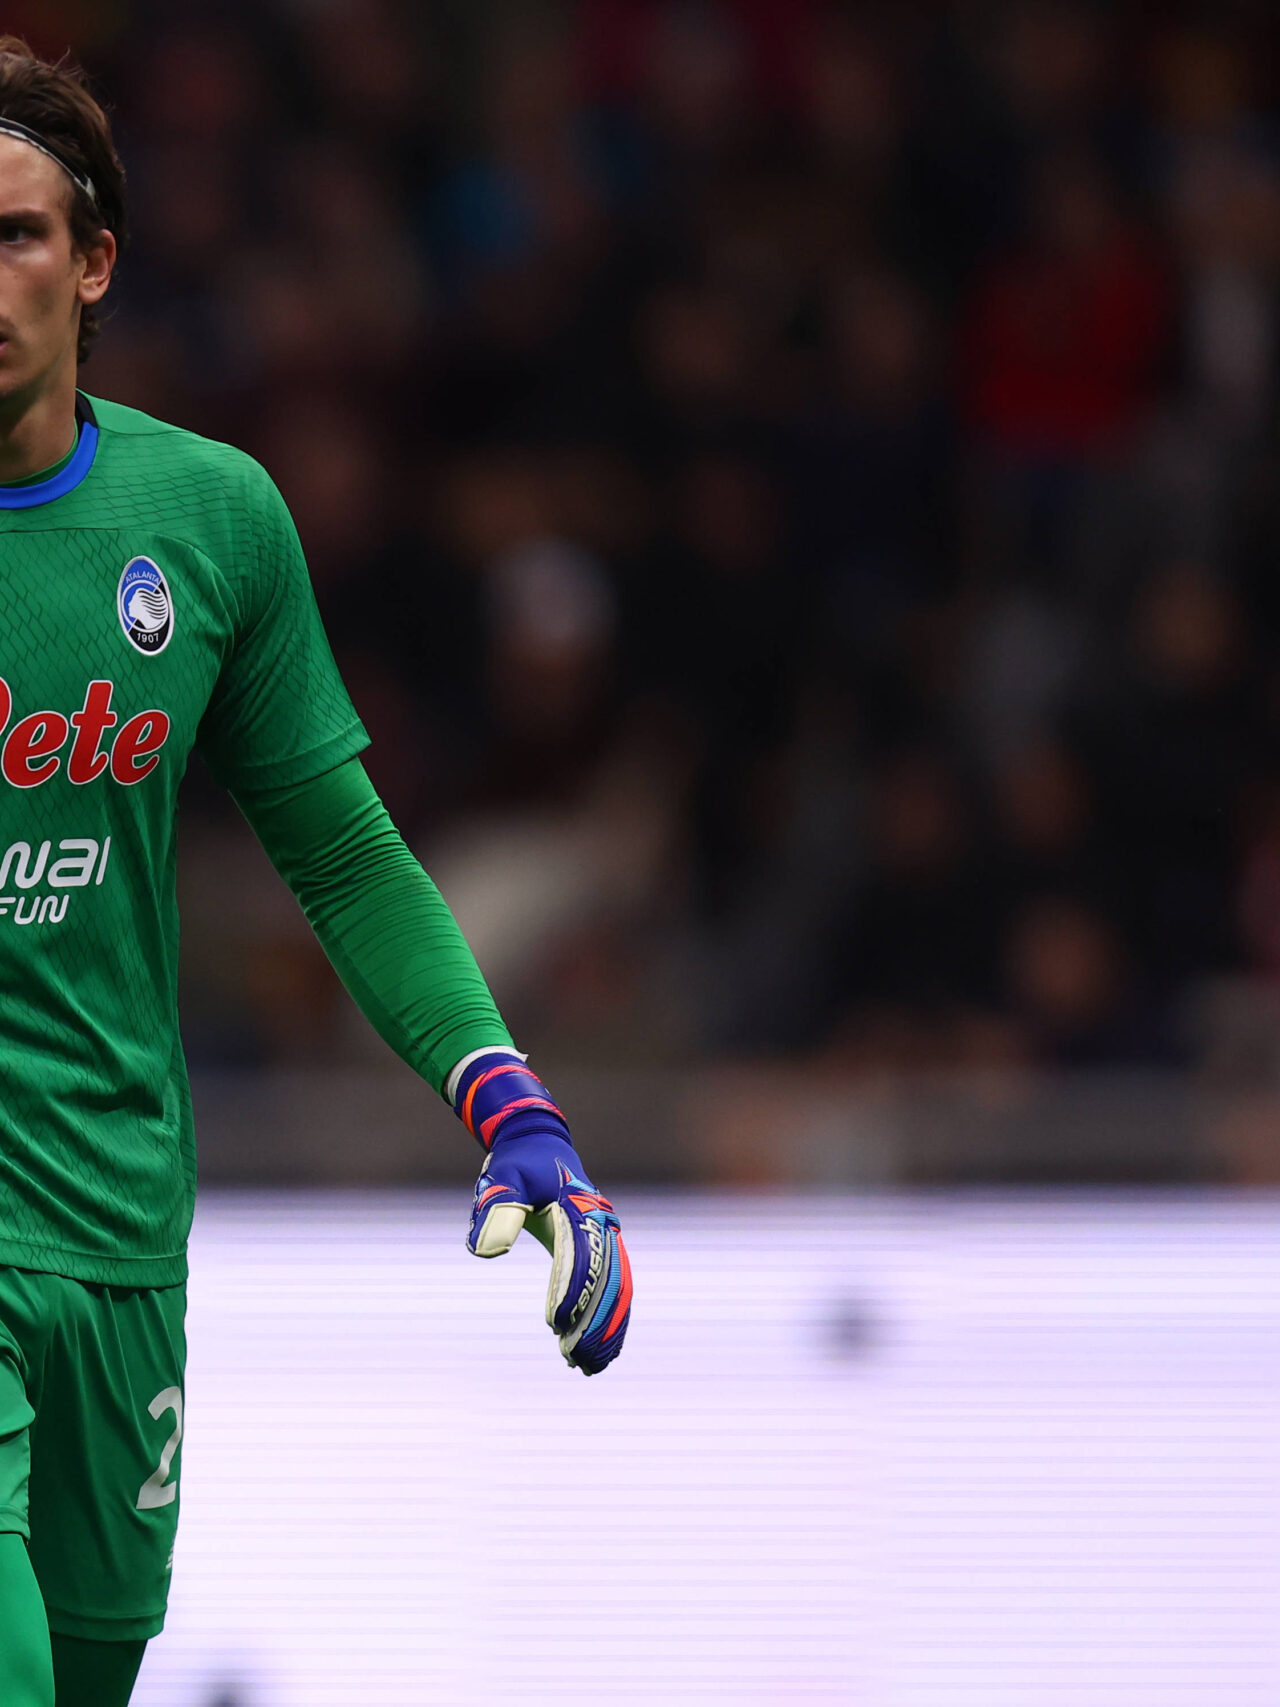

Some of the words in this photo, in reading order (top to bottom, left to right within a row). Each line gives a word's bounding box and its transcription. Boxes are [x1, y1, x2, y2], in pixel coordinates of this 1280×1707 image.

[125, 571, 160, 584] ATALANTA
[136, 632, 160, 643] 1907
[570, 1217, 603, 1324] reusch
[136, 1386, 183, 1509] 2
